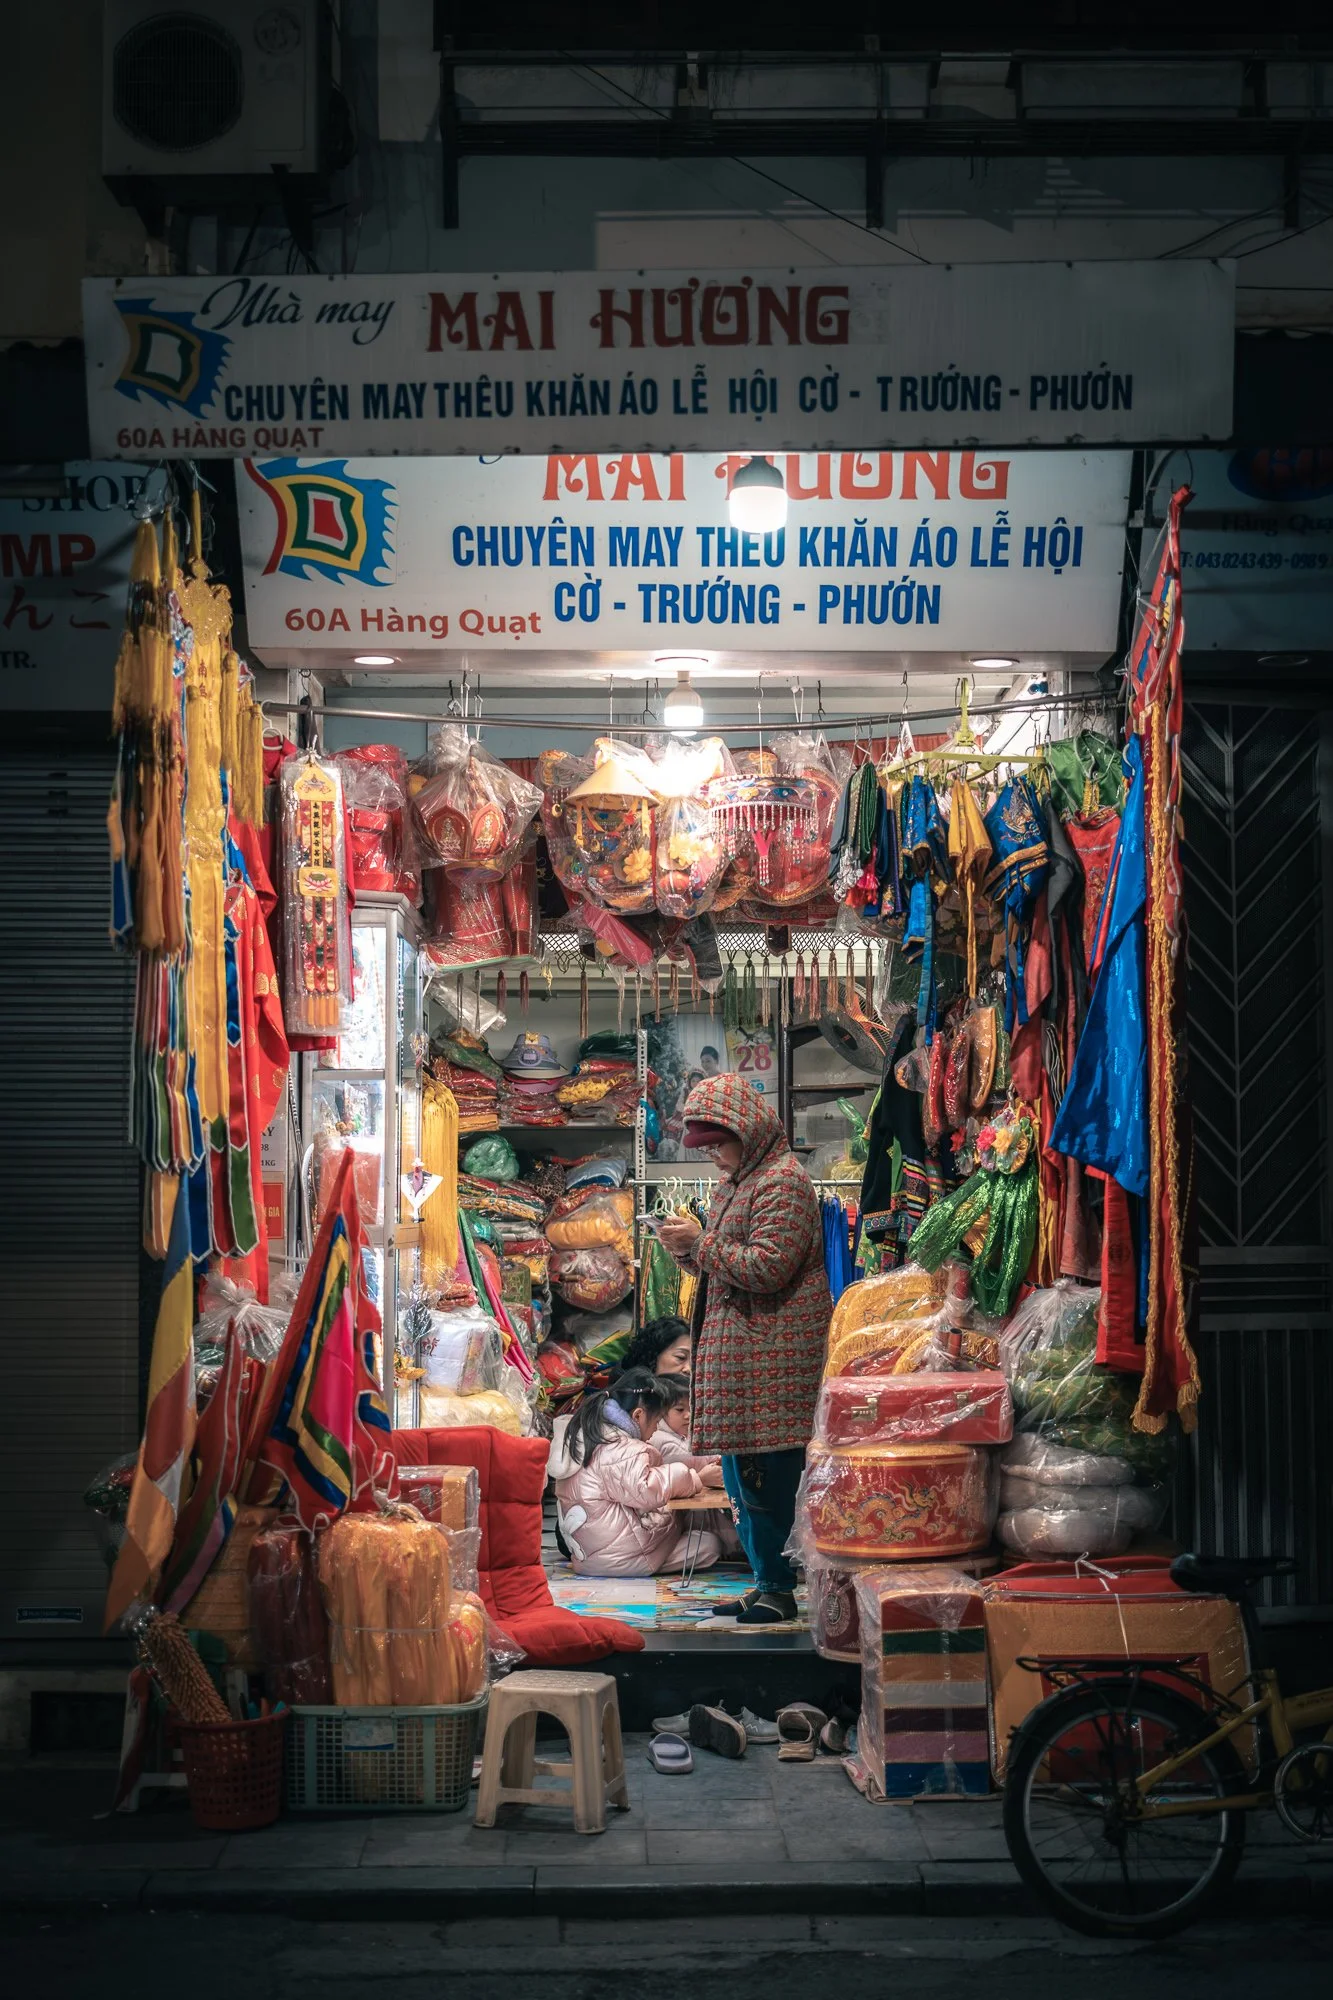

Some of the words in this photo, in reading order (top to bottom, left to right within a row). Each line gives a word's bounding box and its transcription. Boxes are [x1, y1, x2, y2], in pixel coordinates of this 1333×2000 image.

[200, 278, 304, 330] Nhà
[315, 298, 398, 345] may
[427, 291, 556, 352] MAI
[589, 276, 851, 348] HƯƠNG
[224, 377, 350, 422] CHUYÊN
[363, 381, 427, 420] MAY
[434, 374, 514, 418] THÊU
[526, 373, 610, 417] KHĂN
[618, 370, 658, 415] ÁO
[673, 364, 709, 415] LỄ
[728, 368, 777, 422] HỘI
[799, 363, 840, 413] CỜ
[876, 364, 1002, 413] TRƯỚNG
[1030, 361, 1133, 411] PHƯỚN
[116, 427, 166, 449] 60A
[172, 421, 247, 449] HÀNG
[254, 427, 325, 452] QUẠT
[542, 453, 687, 501] MAI
[452, 516, 595, 568] CHUYÊN
[609, 526, 685, 567] MAY
[798, 517, 898, 568] KHĂN
[909, 517, 958, 568] ÁO
[970, 510, 1013, 568] LỄ
[1022, 517, 1083, 575] HỘI
[285, 608, 351, 632] 60A
[360, 606, 449, 639] Hàng
[459, 609, 542, 641] Quạt
[554, 573, 602, 623] CỜ
[638, 575, 780, 624] TRƯỚNG
[818, 575, 941, 625] PHƯỚN
[736, 1043, 772, 1072] 28
